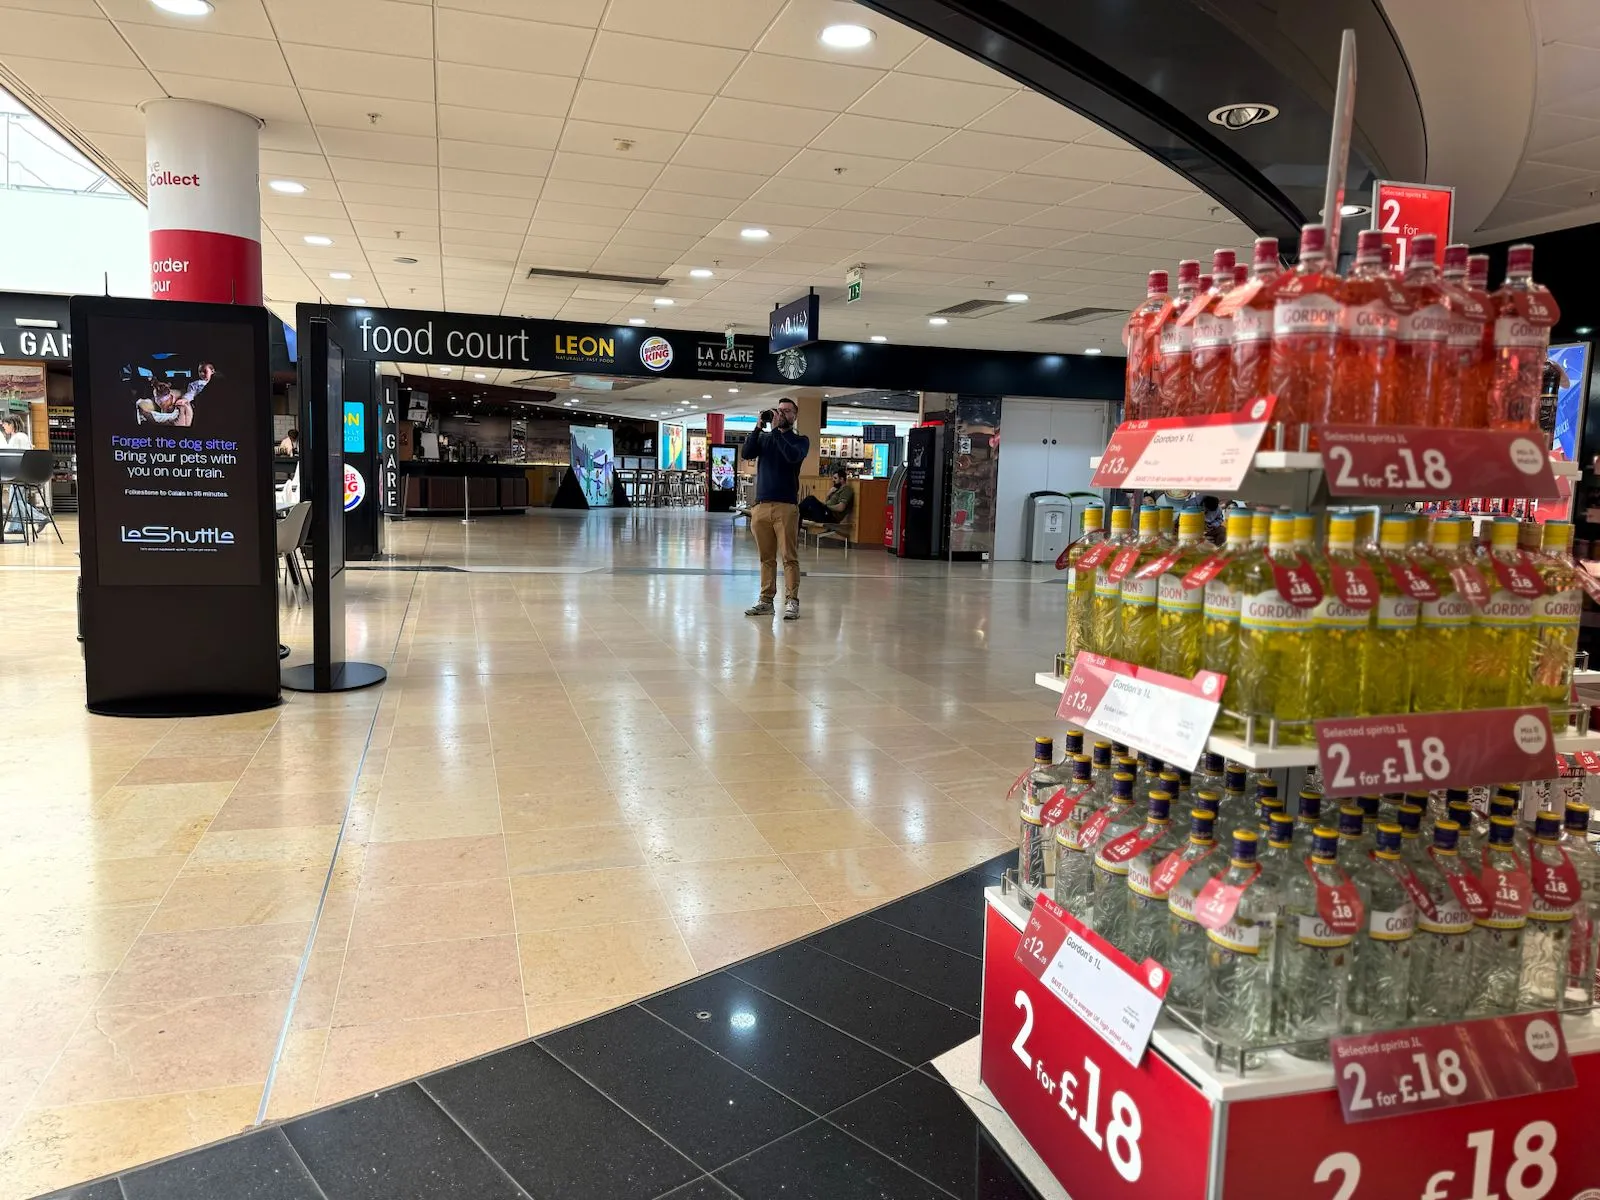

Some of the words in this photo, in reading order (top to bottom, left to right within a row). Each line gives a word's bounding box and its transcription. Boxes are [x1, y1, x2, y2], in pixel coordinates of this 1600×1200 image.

[150, 171, 200, 187] Collect
[1382, 199, 1400, 234] 2
[1403, 224, 1419, 235] for
[152, 257, 189, 273] order
[359, 317, 433, 356] food
[446, 329, 530, 362] court
[555, 334, 615, 358] LEON
[644, 343, 668, 353] BURGER
[645, 350, 669, 362] KING
[697, 346, 714, 360] LA
[720, 348, 754, 363] GARE
[385, 388, 396, 424] LA
[111, 435, 152, 449] Forget
[155, 437, 176, 448] the
[179, 438, 202, 451] dog
[205, 439, 239, 451] sitter.
[114, 450, 147, 464] Bring
[150, 453, 177, 464] your
[180, 454, 207, 465] pets
[210, 454, 236, 465] with
[127, 466, 150, 478] you
[153, 467, 169, 477] on
[172, 468, 192, 478] our
[195, 467, 225, 479] train.
[386, 433, 397, 507] GARE
[1329, 445, 1359, 487] 2
[1362, 473, 1383, 488] for
[1384, 448, 1452, 490] £18
[167, 489, 186, 497] Calais
[121, 525, 235, 544] LeShuttle
[1287, 571, 1298, 583] 2
[1345, 571, 1355, 583] 2
[1112, 678, 1142, 695] Gordon's
[1323, 726, 1365, 738] Selected
[1366, 724, 1396, 737] spirits
[1327, 743, 1356, 788] 2
[1359, 771, 1380, 786] for
[1383, 737, 1451, 784] £18
[1499, 875, 1507, 886] 2
[1546, 868, 1555, 879] 2
[1214, 887, 1224, 899] 2
[1331, 891, 1341, 904] 2
[1031, 917, 1042, 931] Only
[1066, 936, 1093, 963] Gordon's
[1094, 959, 1101, 971] 1L
[1337, 1041, 1380, 1058] Selected
[1381, 1039, 1410, 1054] spirits
[1011, 989, 1034, 1071] 2
[1036, 1059, 1056, 1095] for
[1059, 1056, 1142, 1183] £18
[1343, 1062, 1374, 1111] 2
[1376, 1091, 1398, 1107] for
[1399, 1049, 1468, 1104] £18
